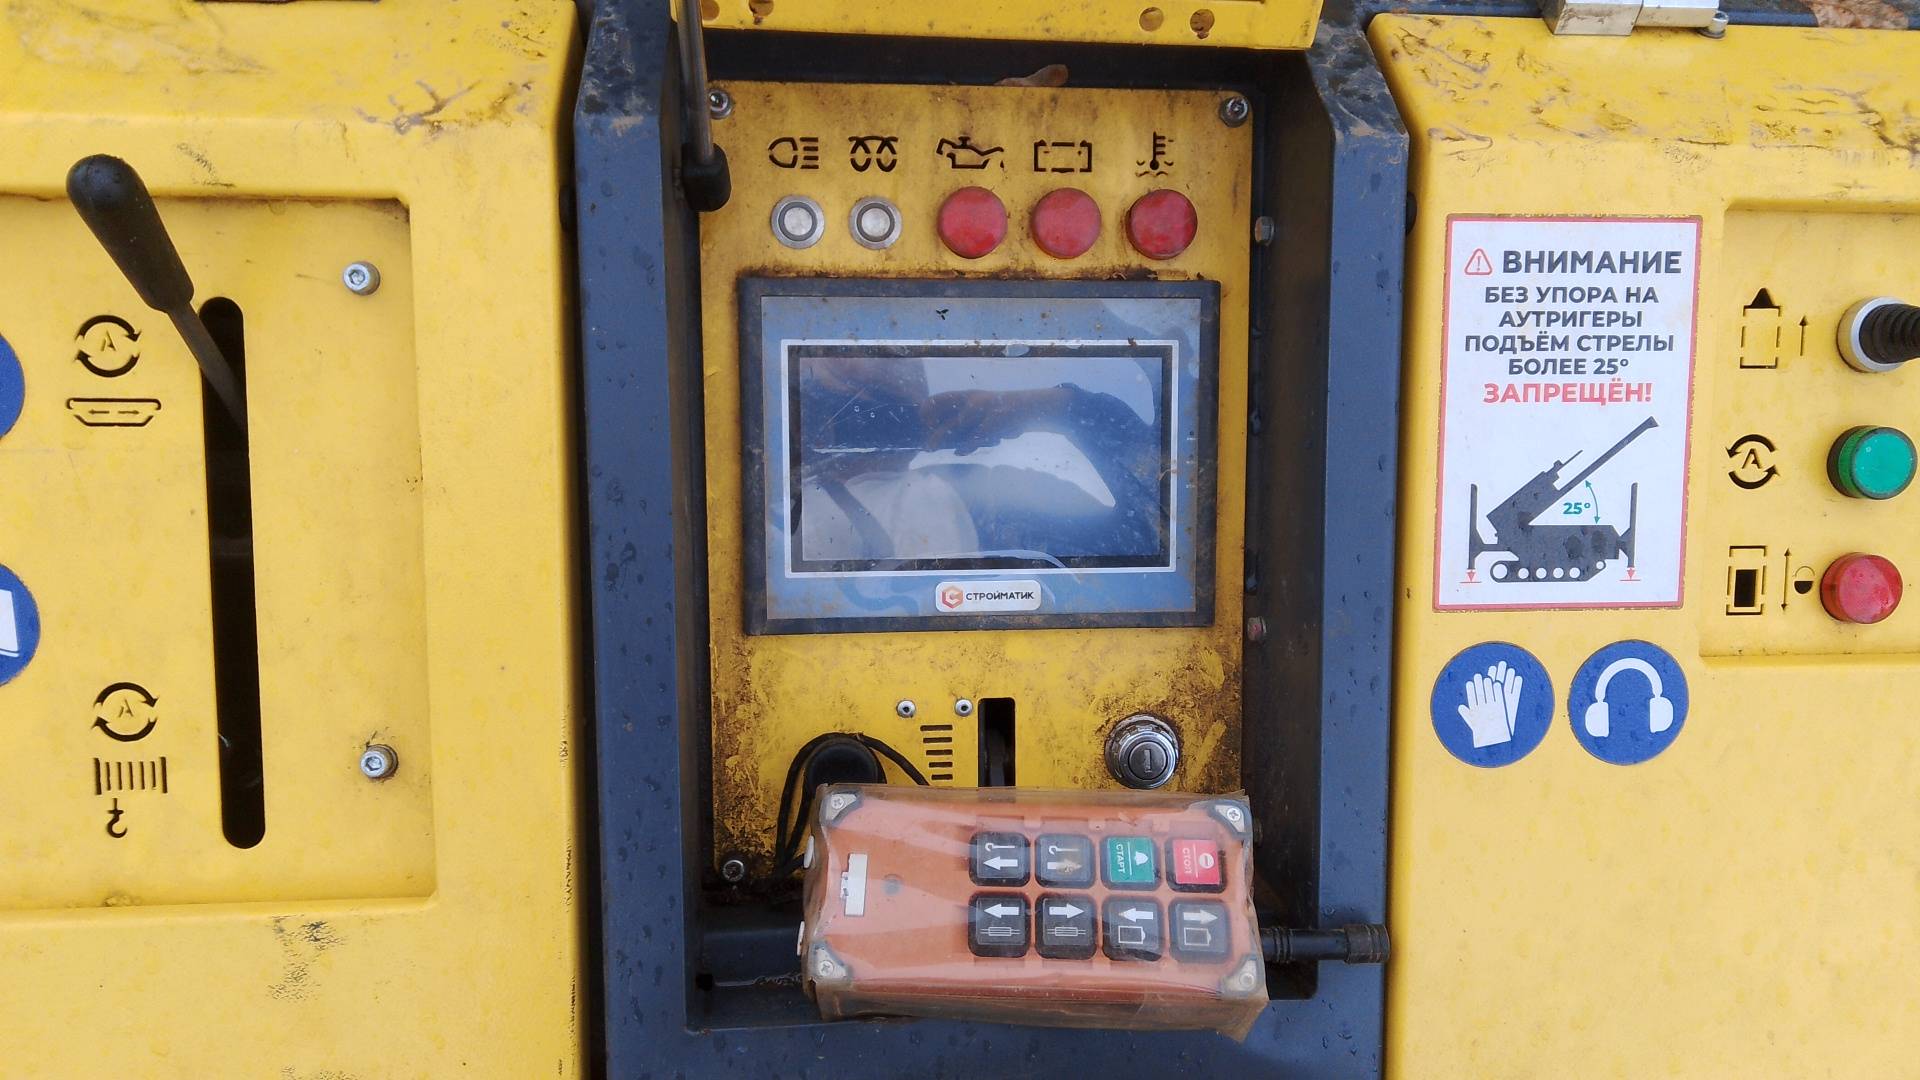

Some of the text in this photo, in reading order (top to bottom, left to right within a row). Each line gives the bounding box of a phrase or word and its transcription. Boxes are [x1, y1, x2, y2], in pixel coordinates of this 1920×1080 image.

[1503, 251, 1682, 274] ВНИМАНИЕ
[1485, 286, 1659, 303] БЕЗ УПОРА НА
[1498, 310, 1642, 327] АУТРИГЕРЫ
[1465, 331, 1674, 354] ПОДЪЁМ СТРЕЛЫ
[1508, 358, 1587, 375] БОЛЕЕ
[1483, 378, 1652, 405] ЗАПРЕЩЁН!
[965, 590, 1034, 600] СТРОЙМАТИК
[1116, 843, 1126, 873] СТАРТ
